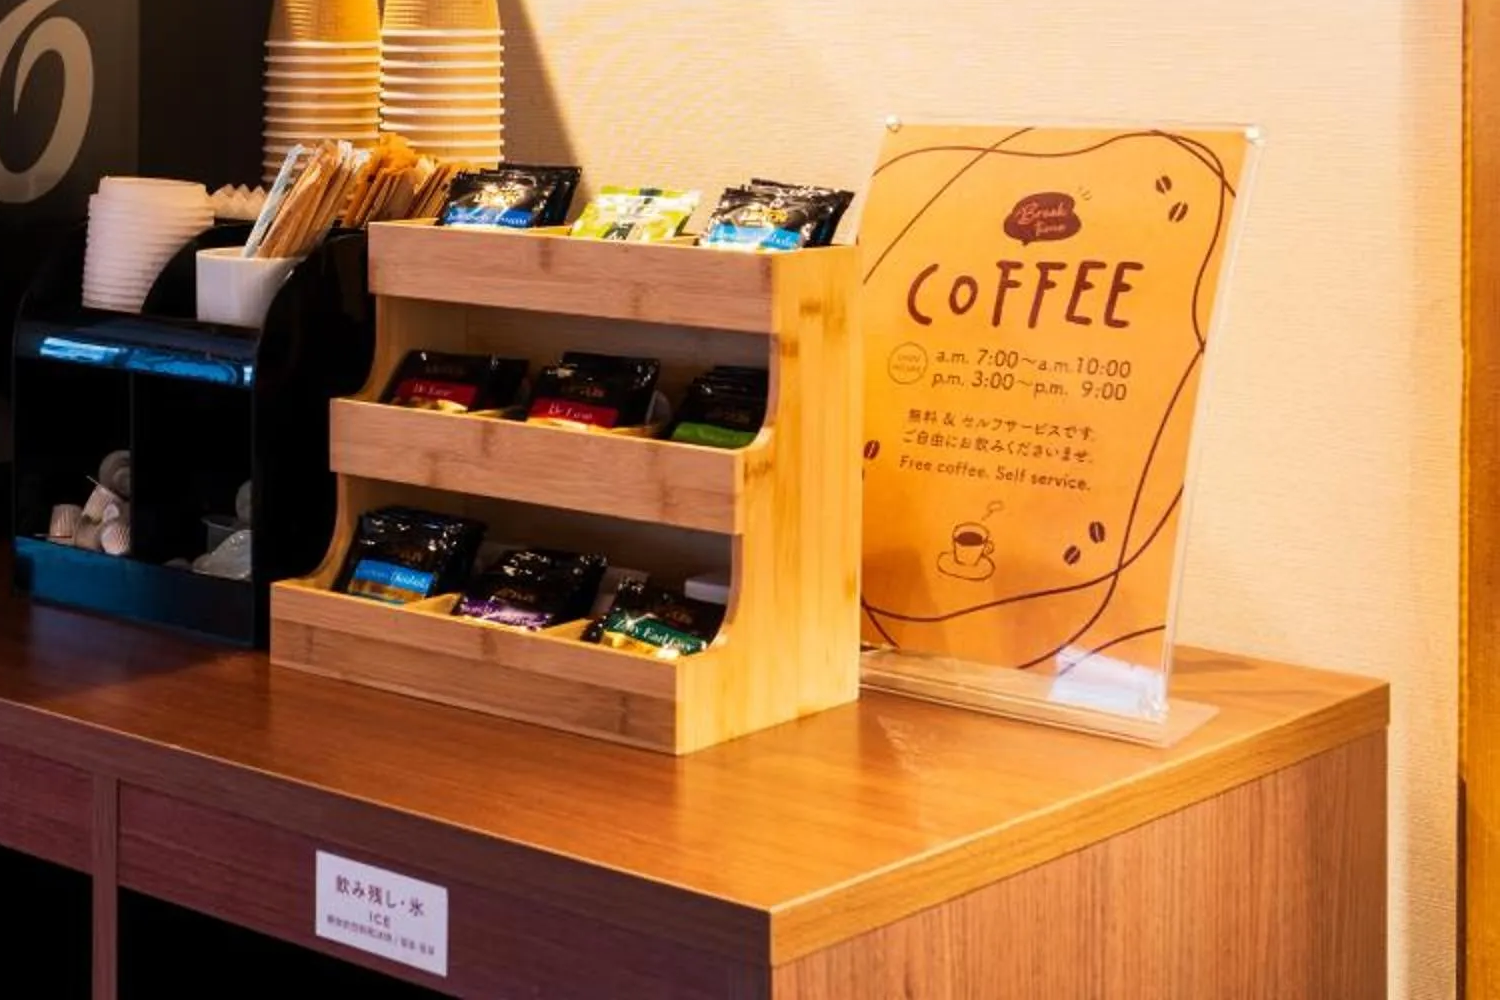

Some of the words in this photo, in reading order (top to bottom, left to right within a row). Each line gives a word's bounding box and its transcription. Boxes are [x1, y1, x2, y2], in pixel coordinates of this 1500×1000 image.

[1081, 380, 1127, 401] 9:00
[900, 455, 932, 471] Free
[995, 465, 1026, 483] Self
[370, 911, 391, 928] ICE
